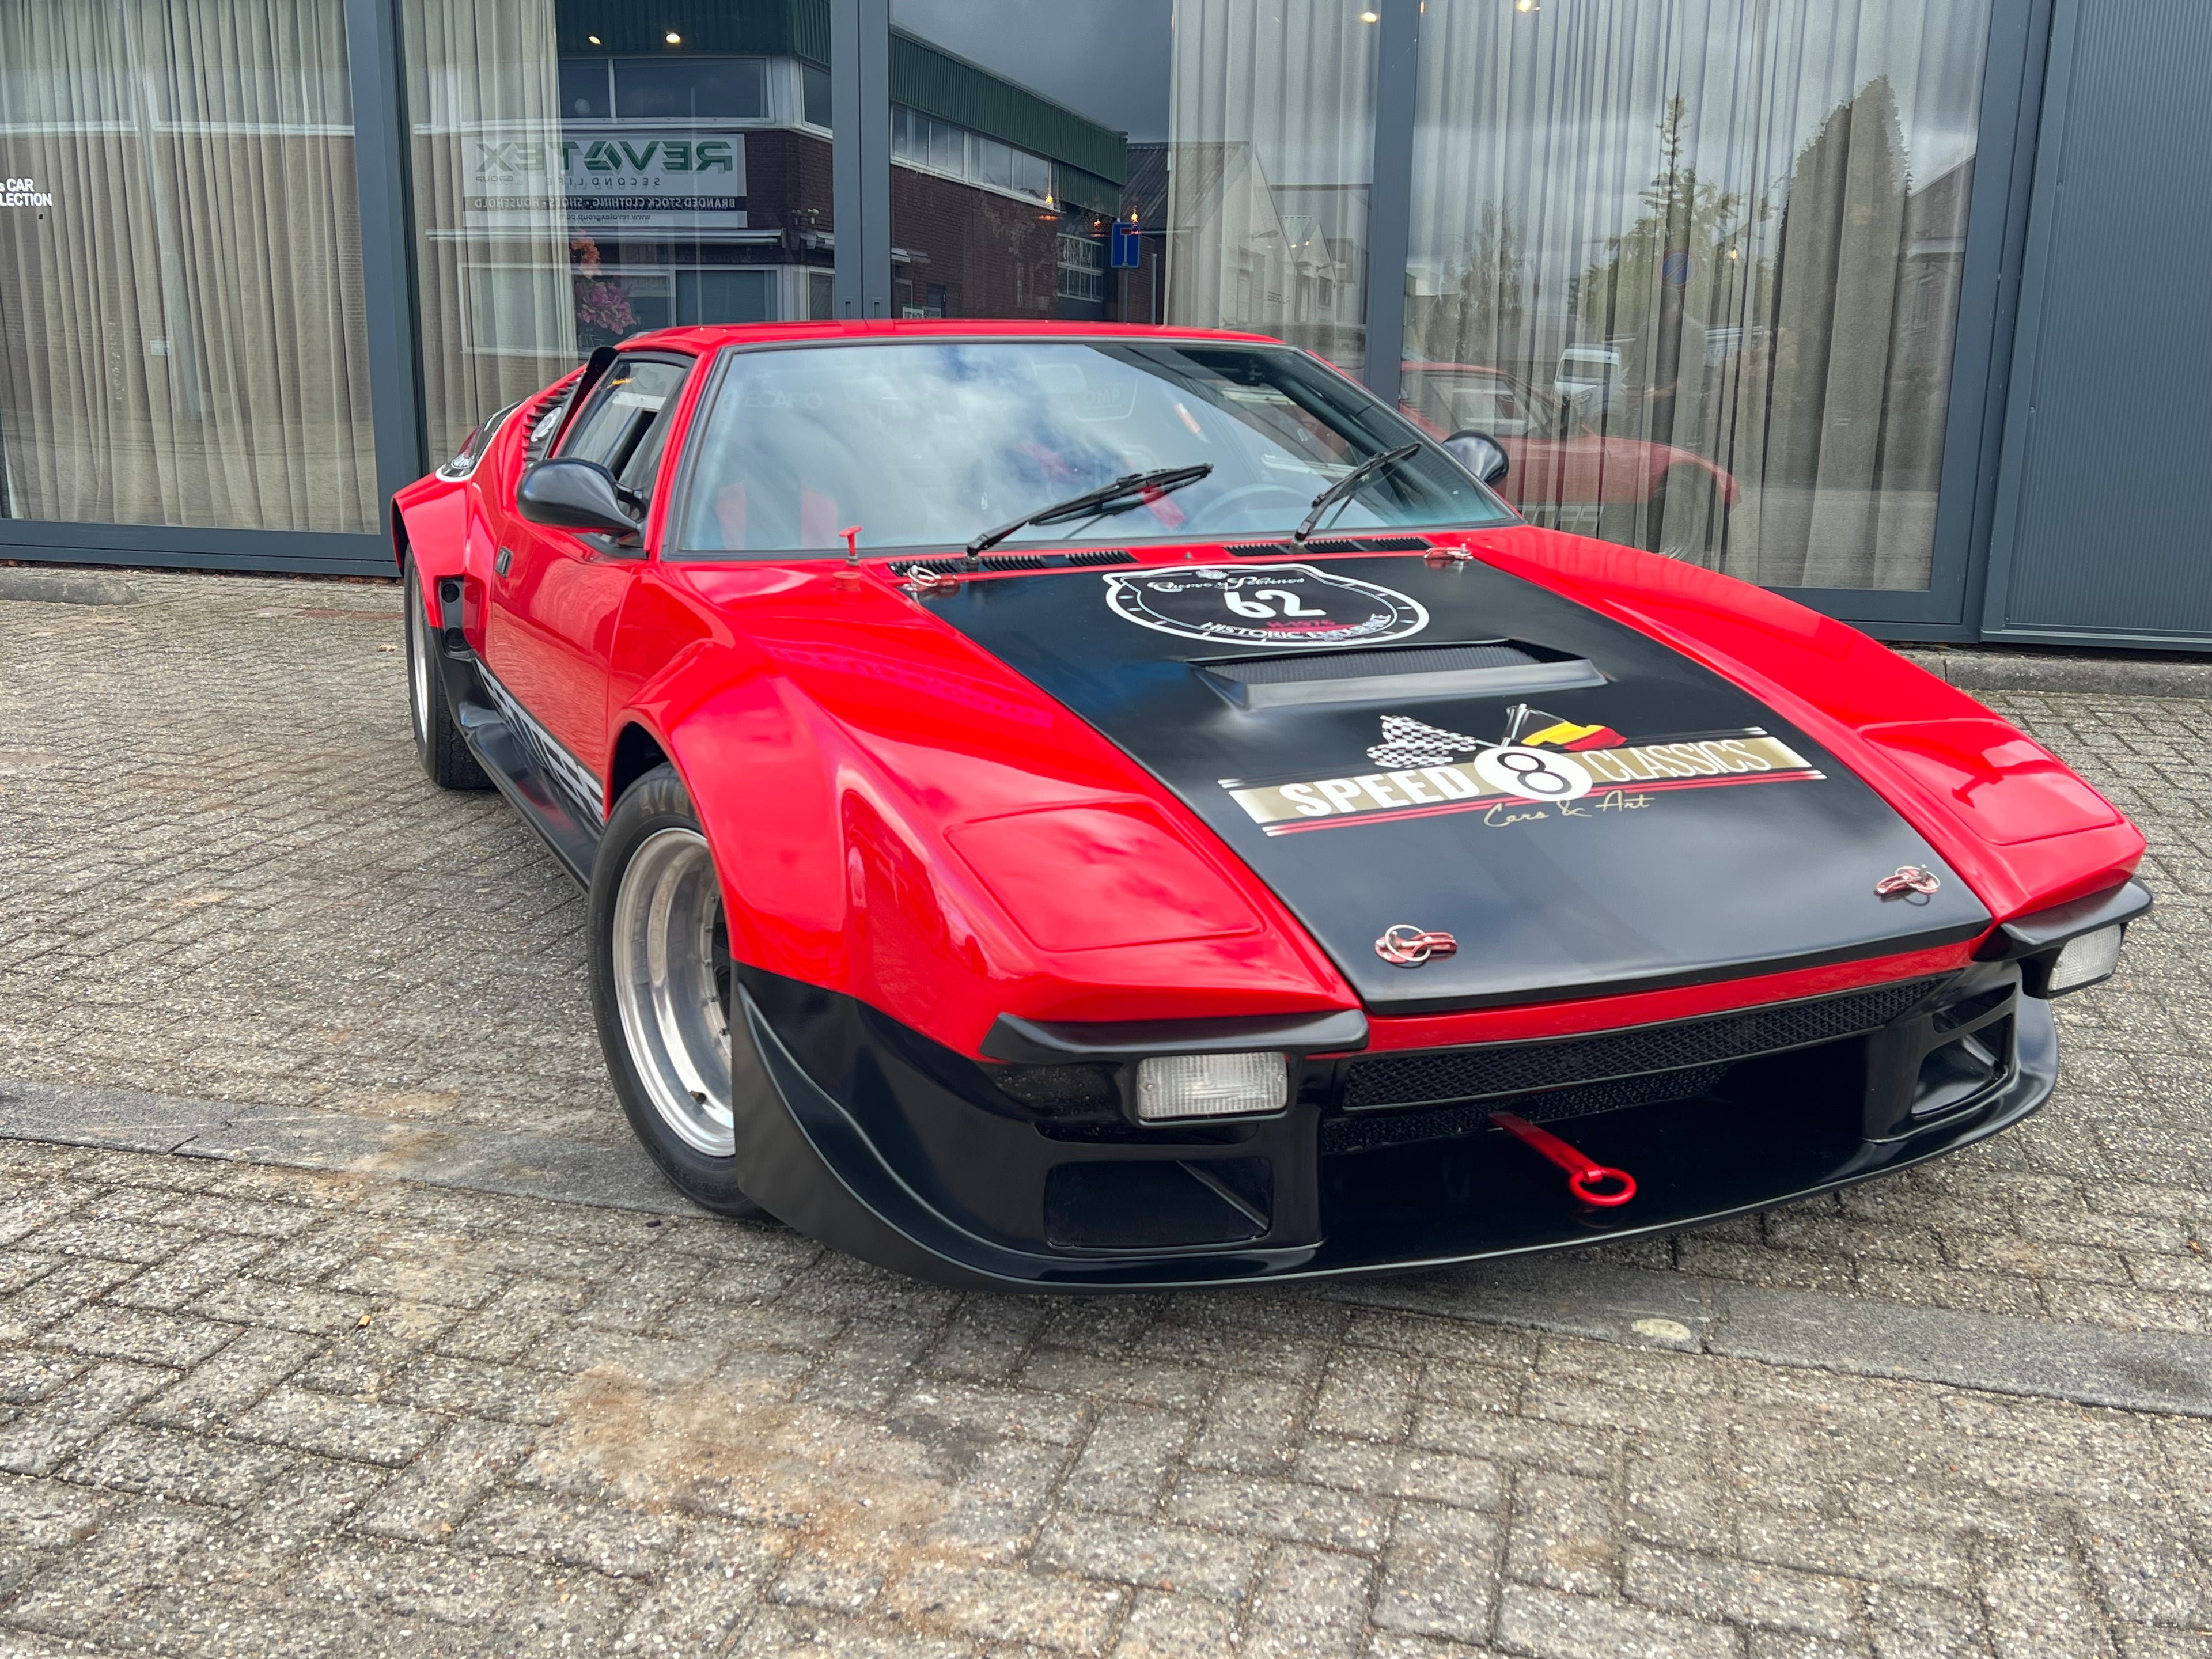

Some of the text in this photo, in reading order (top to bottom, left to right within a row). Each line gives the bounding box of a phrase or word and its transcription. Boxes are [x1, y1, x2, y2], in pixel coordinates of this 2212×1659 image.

[6, 178, 34, 192] CAR
[1224, 589, 1327, 619] 62
[1279, 739, 1772, 817] SPEED 8 CLASSICS
[1483, 790, 1656, 827] Cars & Art
